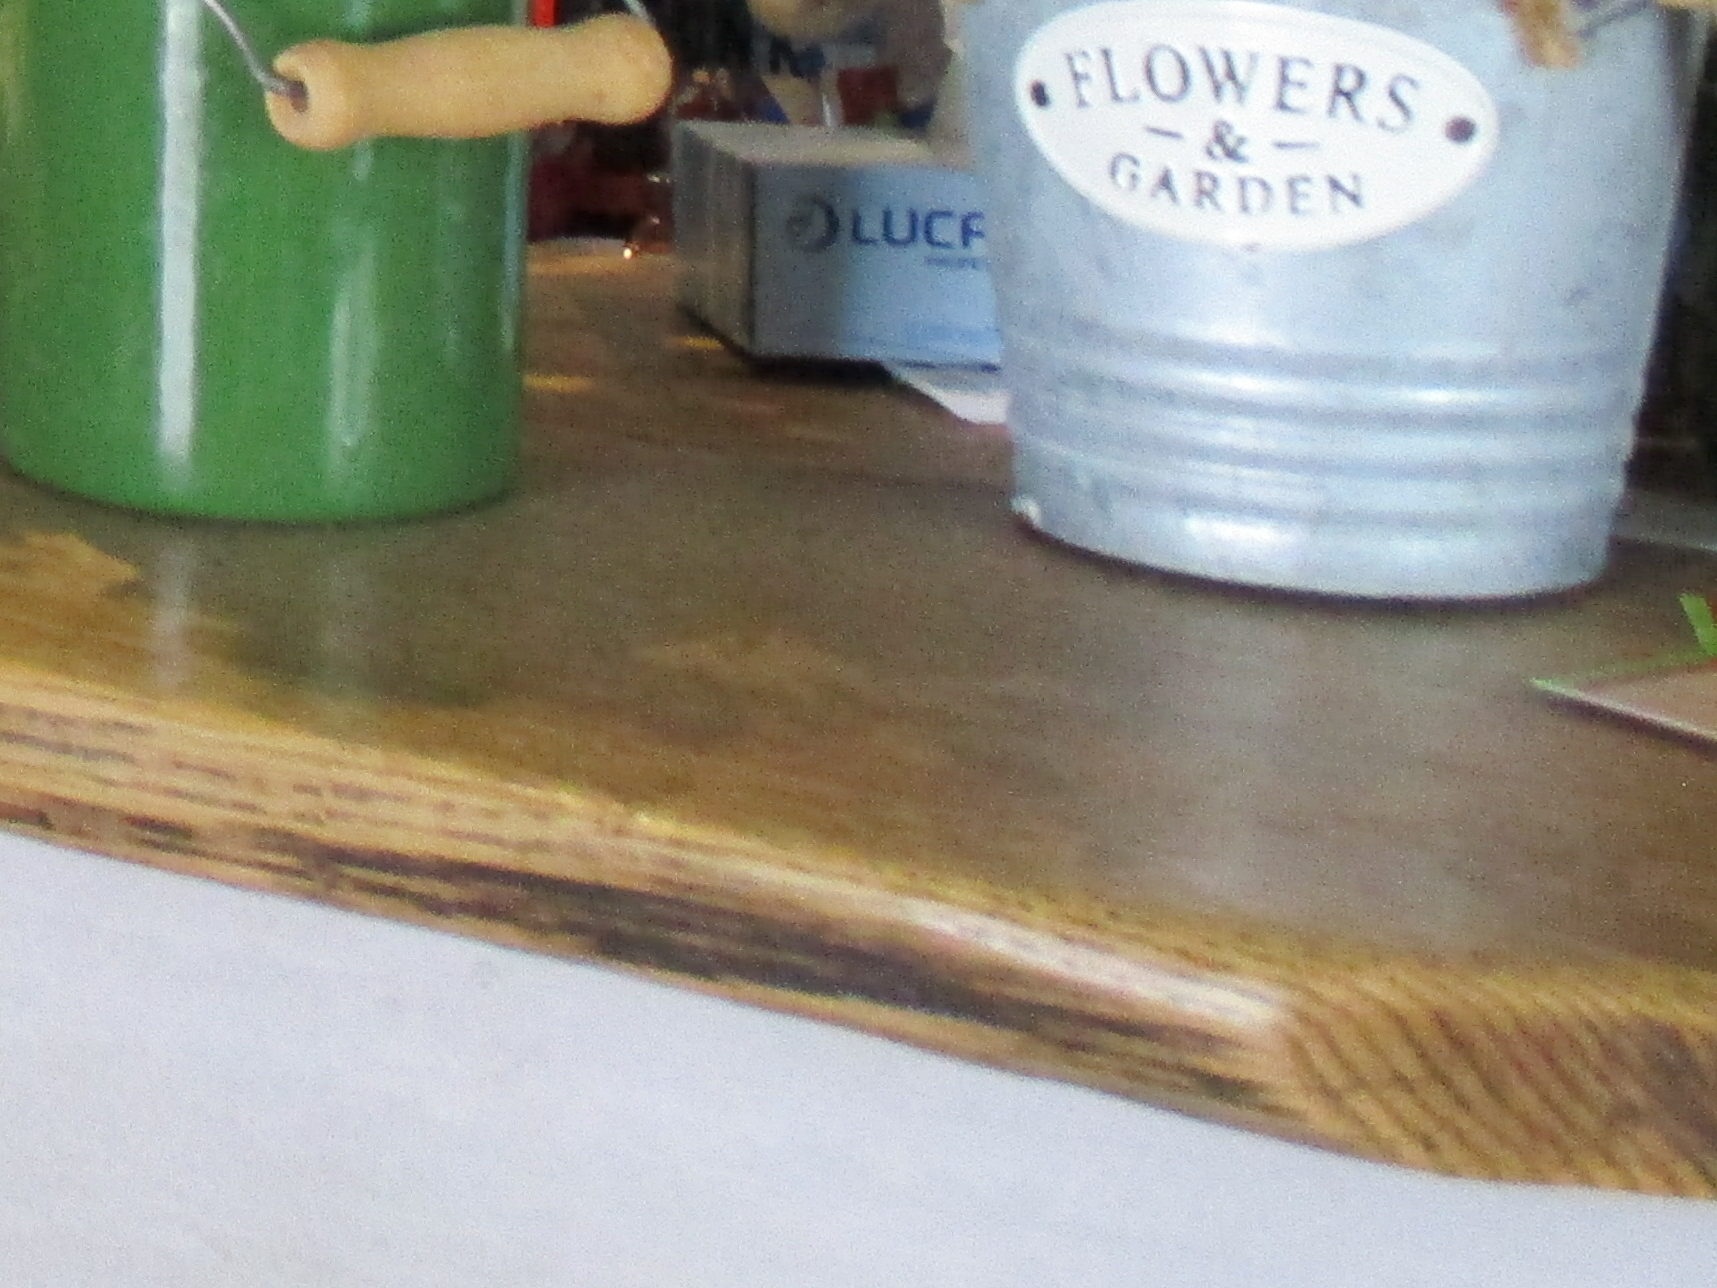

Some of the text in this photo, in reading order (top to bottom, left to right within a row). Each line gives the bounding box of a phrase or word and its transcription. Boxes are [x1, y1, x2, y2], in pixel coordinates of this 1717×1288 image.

[1064, 42, 1421, 136] FLOWERS
[1205, 119, 1252, 166] &
[1108, 152, 1367, 220] GARDEN
